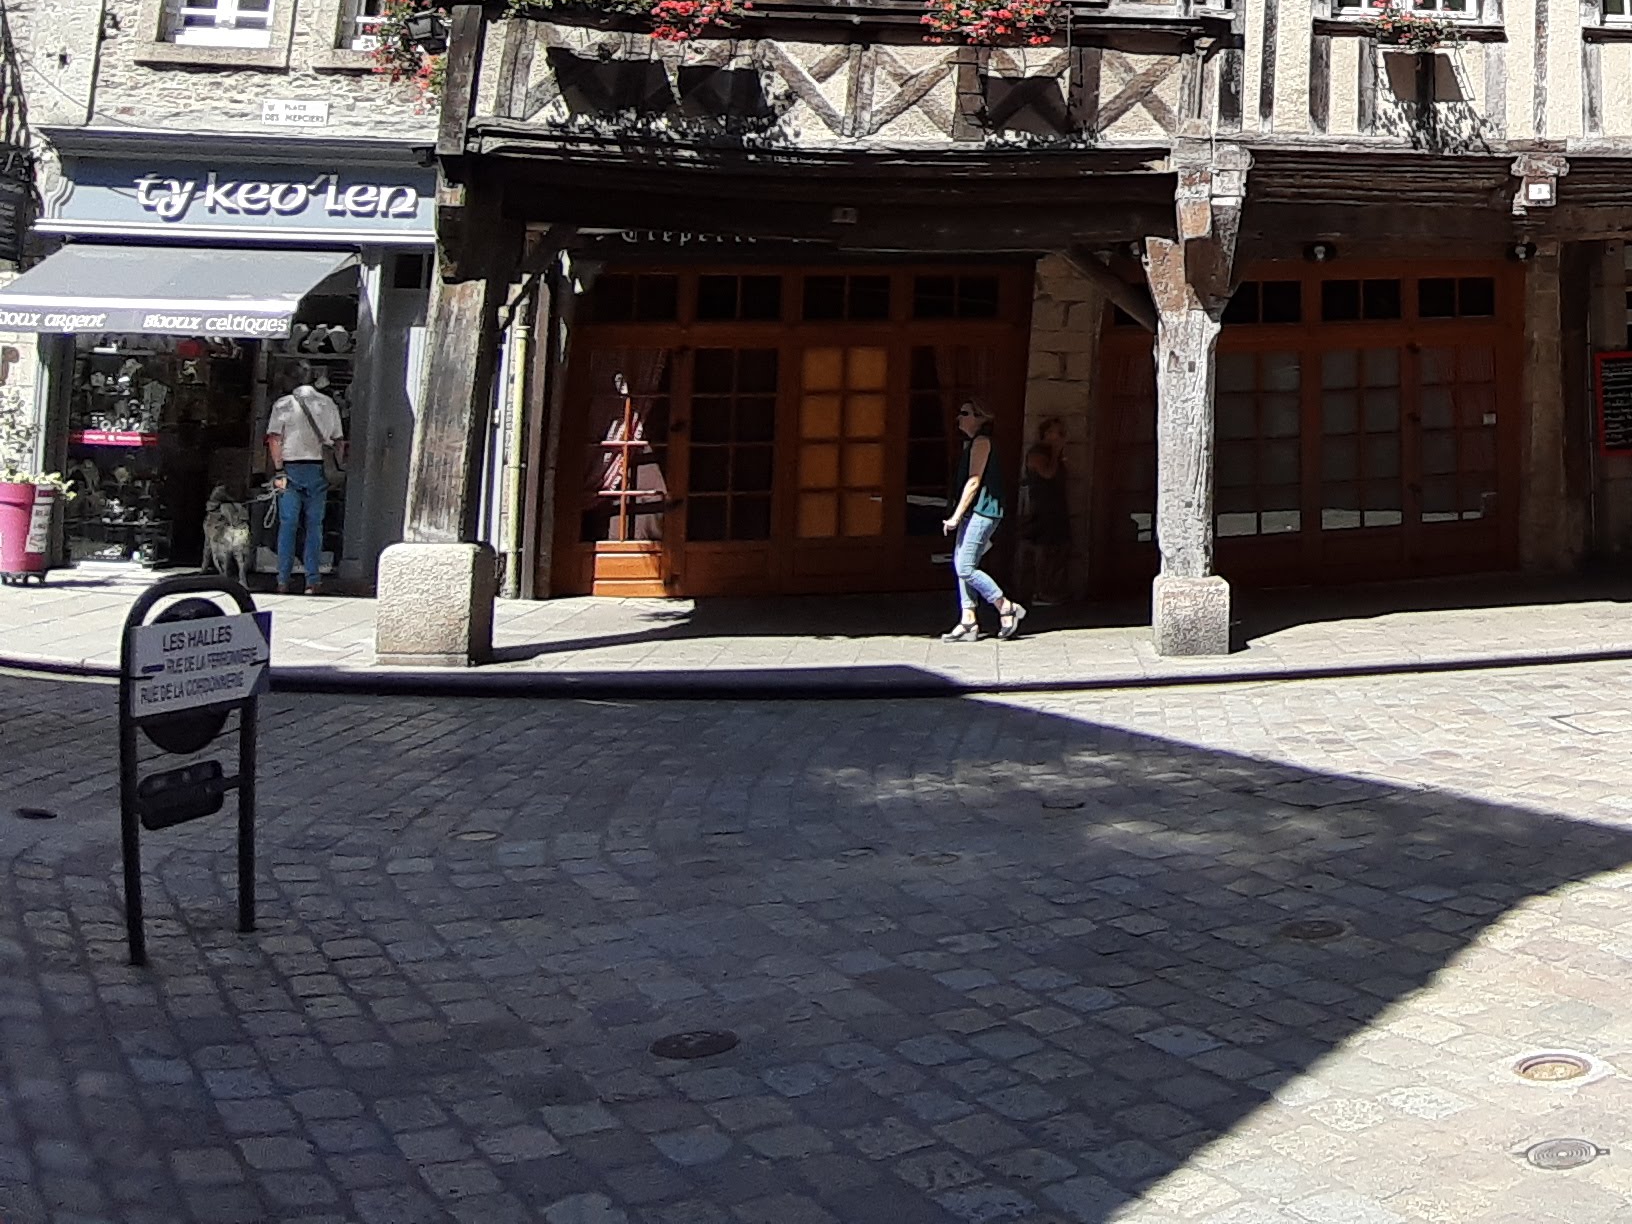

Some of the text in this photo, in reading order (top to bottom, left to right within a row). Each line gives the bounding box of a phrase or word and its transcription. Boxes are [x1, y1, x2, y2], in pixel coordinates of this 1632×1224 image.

[284, 104, 307, 112] PLACE
[162, 624, 232, 652] LES HALLES
